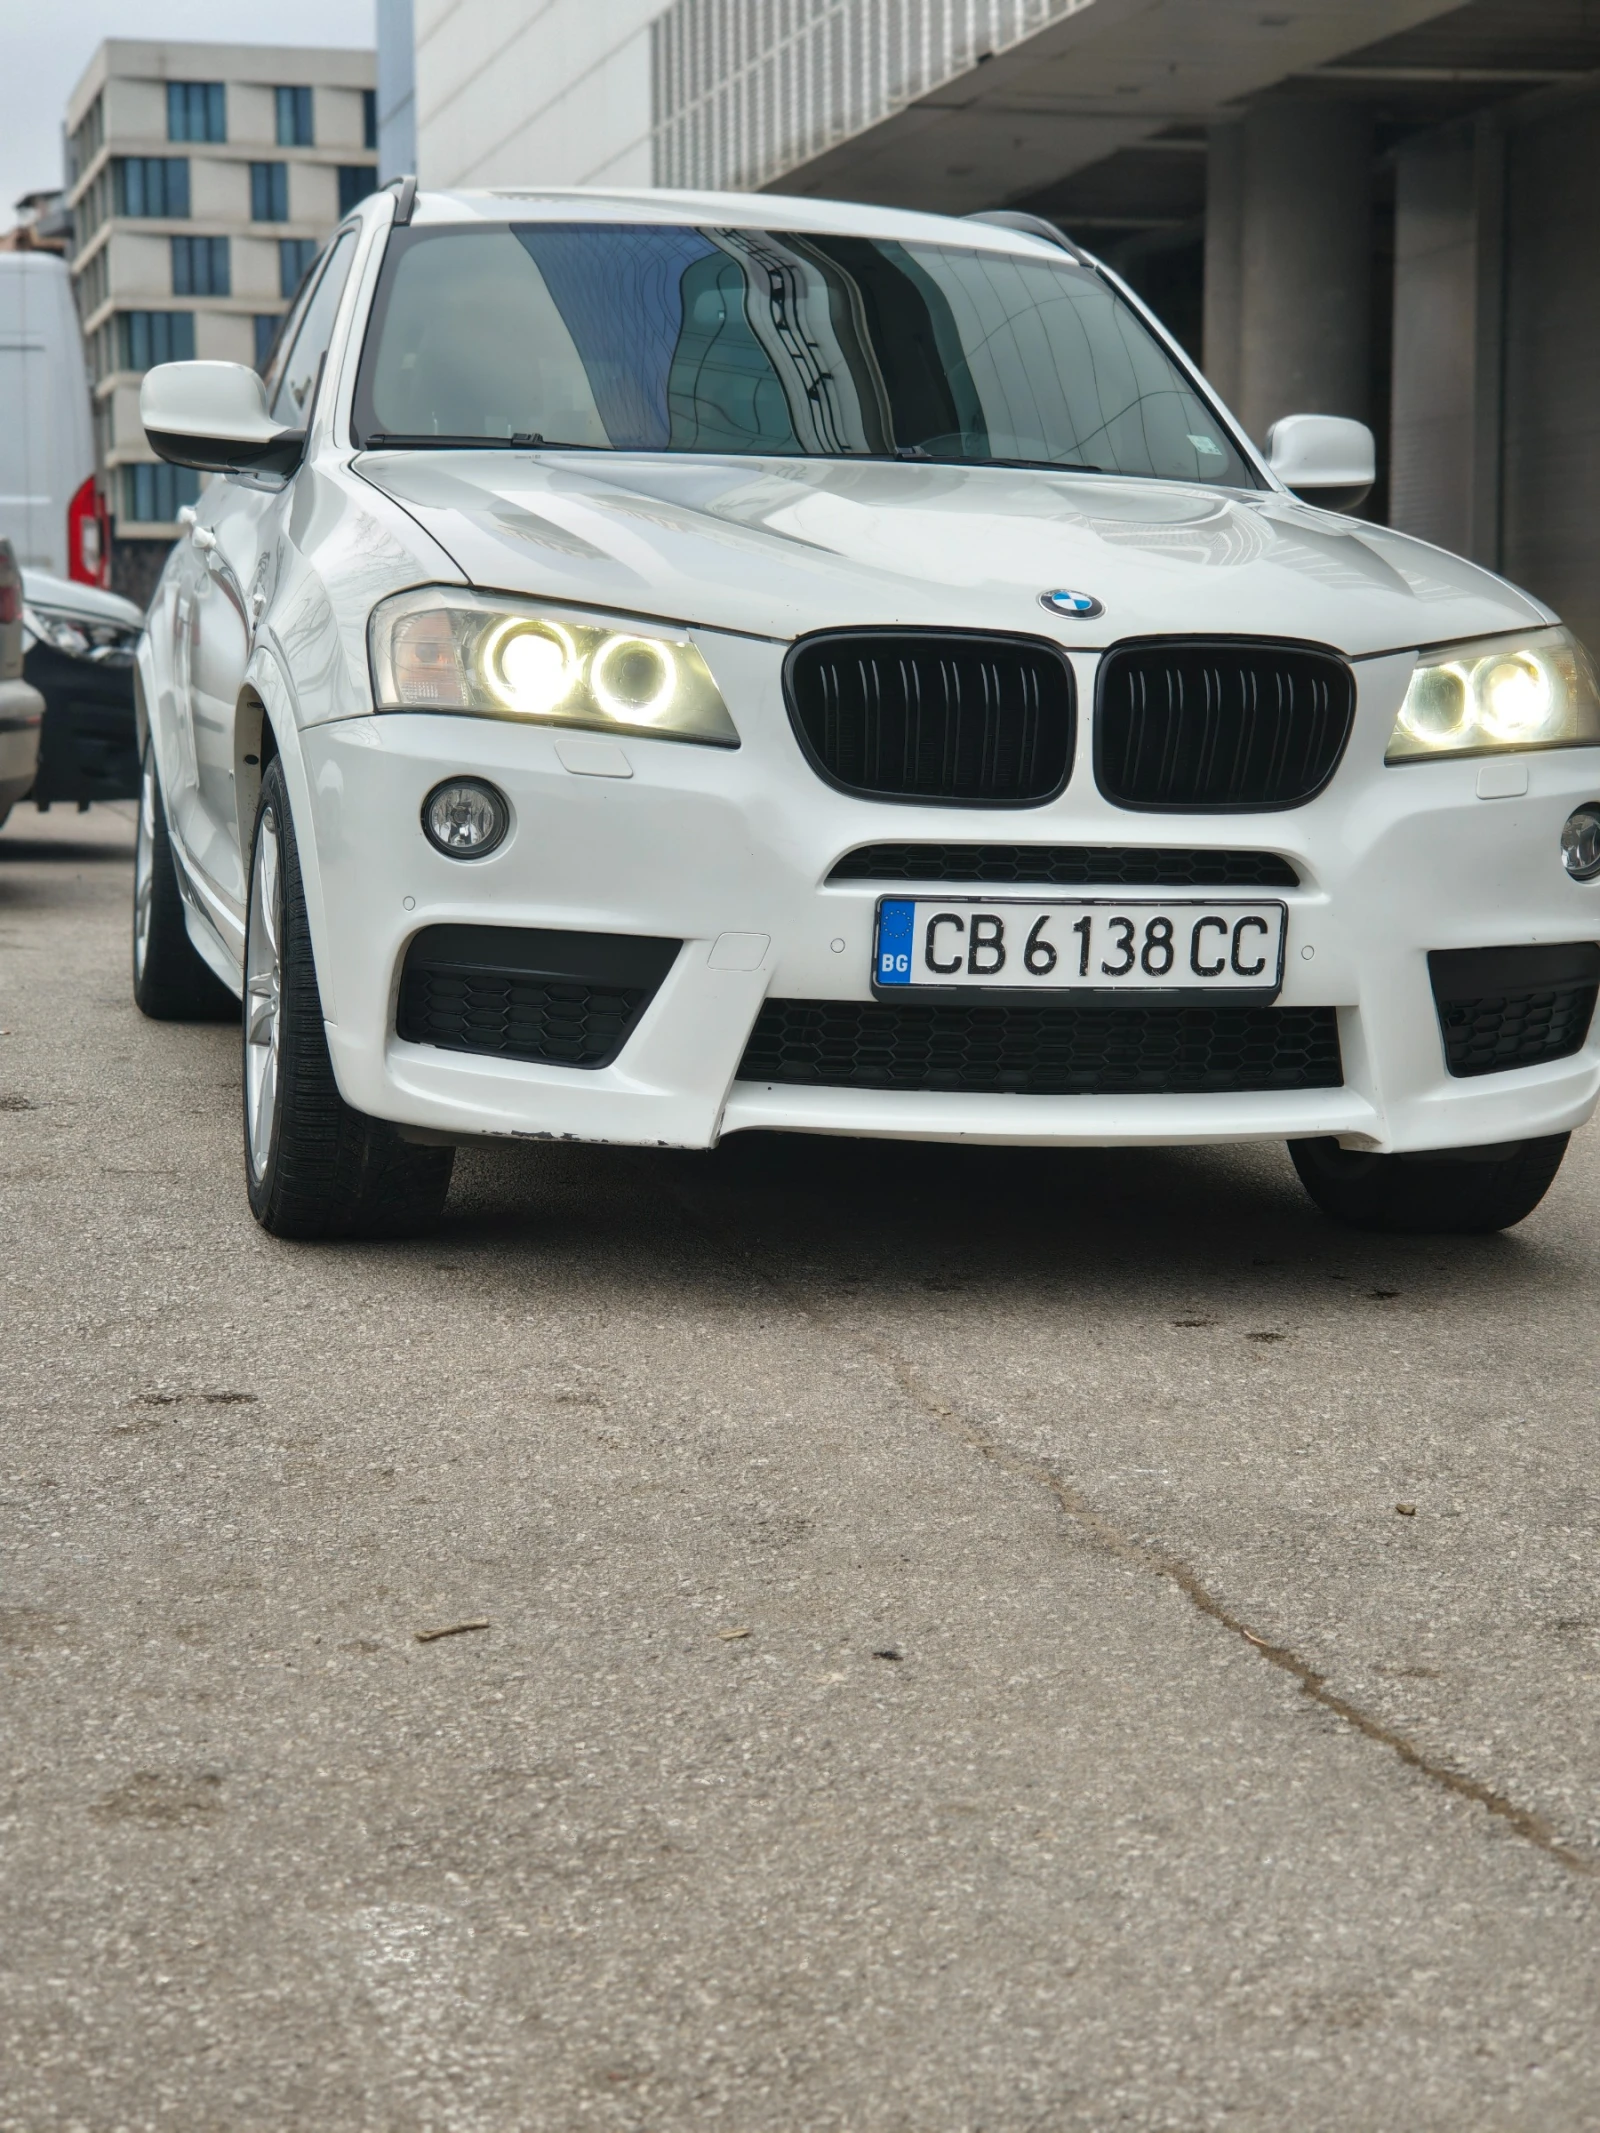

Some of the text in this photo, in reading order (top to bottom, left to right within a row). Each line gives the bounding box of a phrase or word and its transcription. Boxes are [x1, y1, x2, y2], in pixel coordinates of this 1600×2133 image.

[881, 953, 908, 972] BG
[925, 912, 1268, 977] CB 6138 CC
